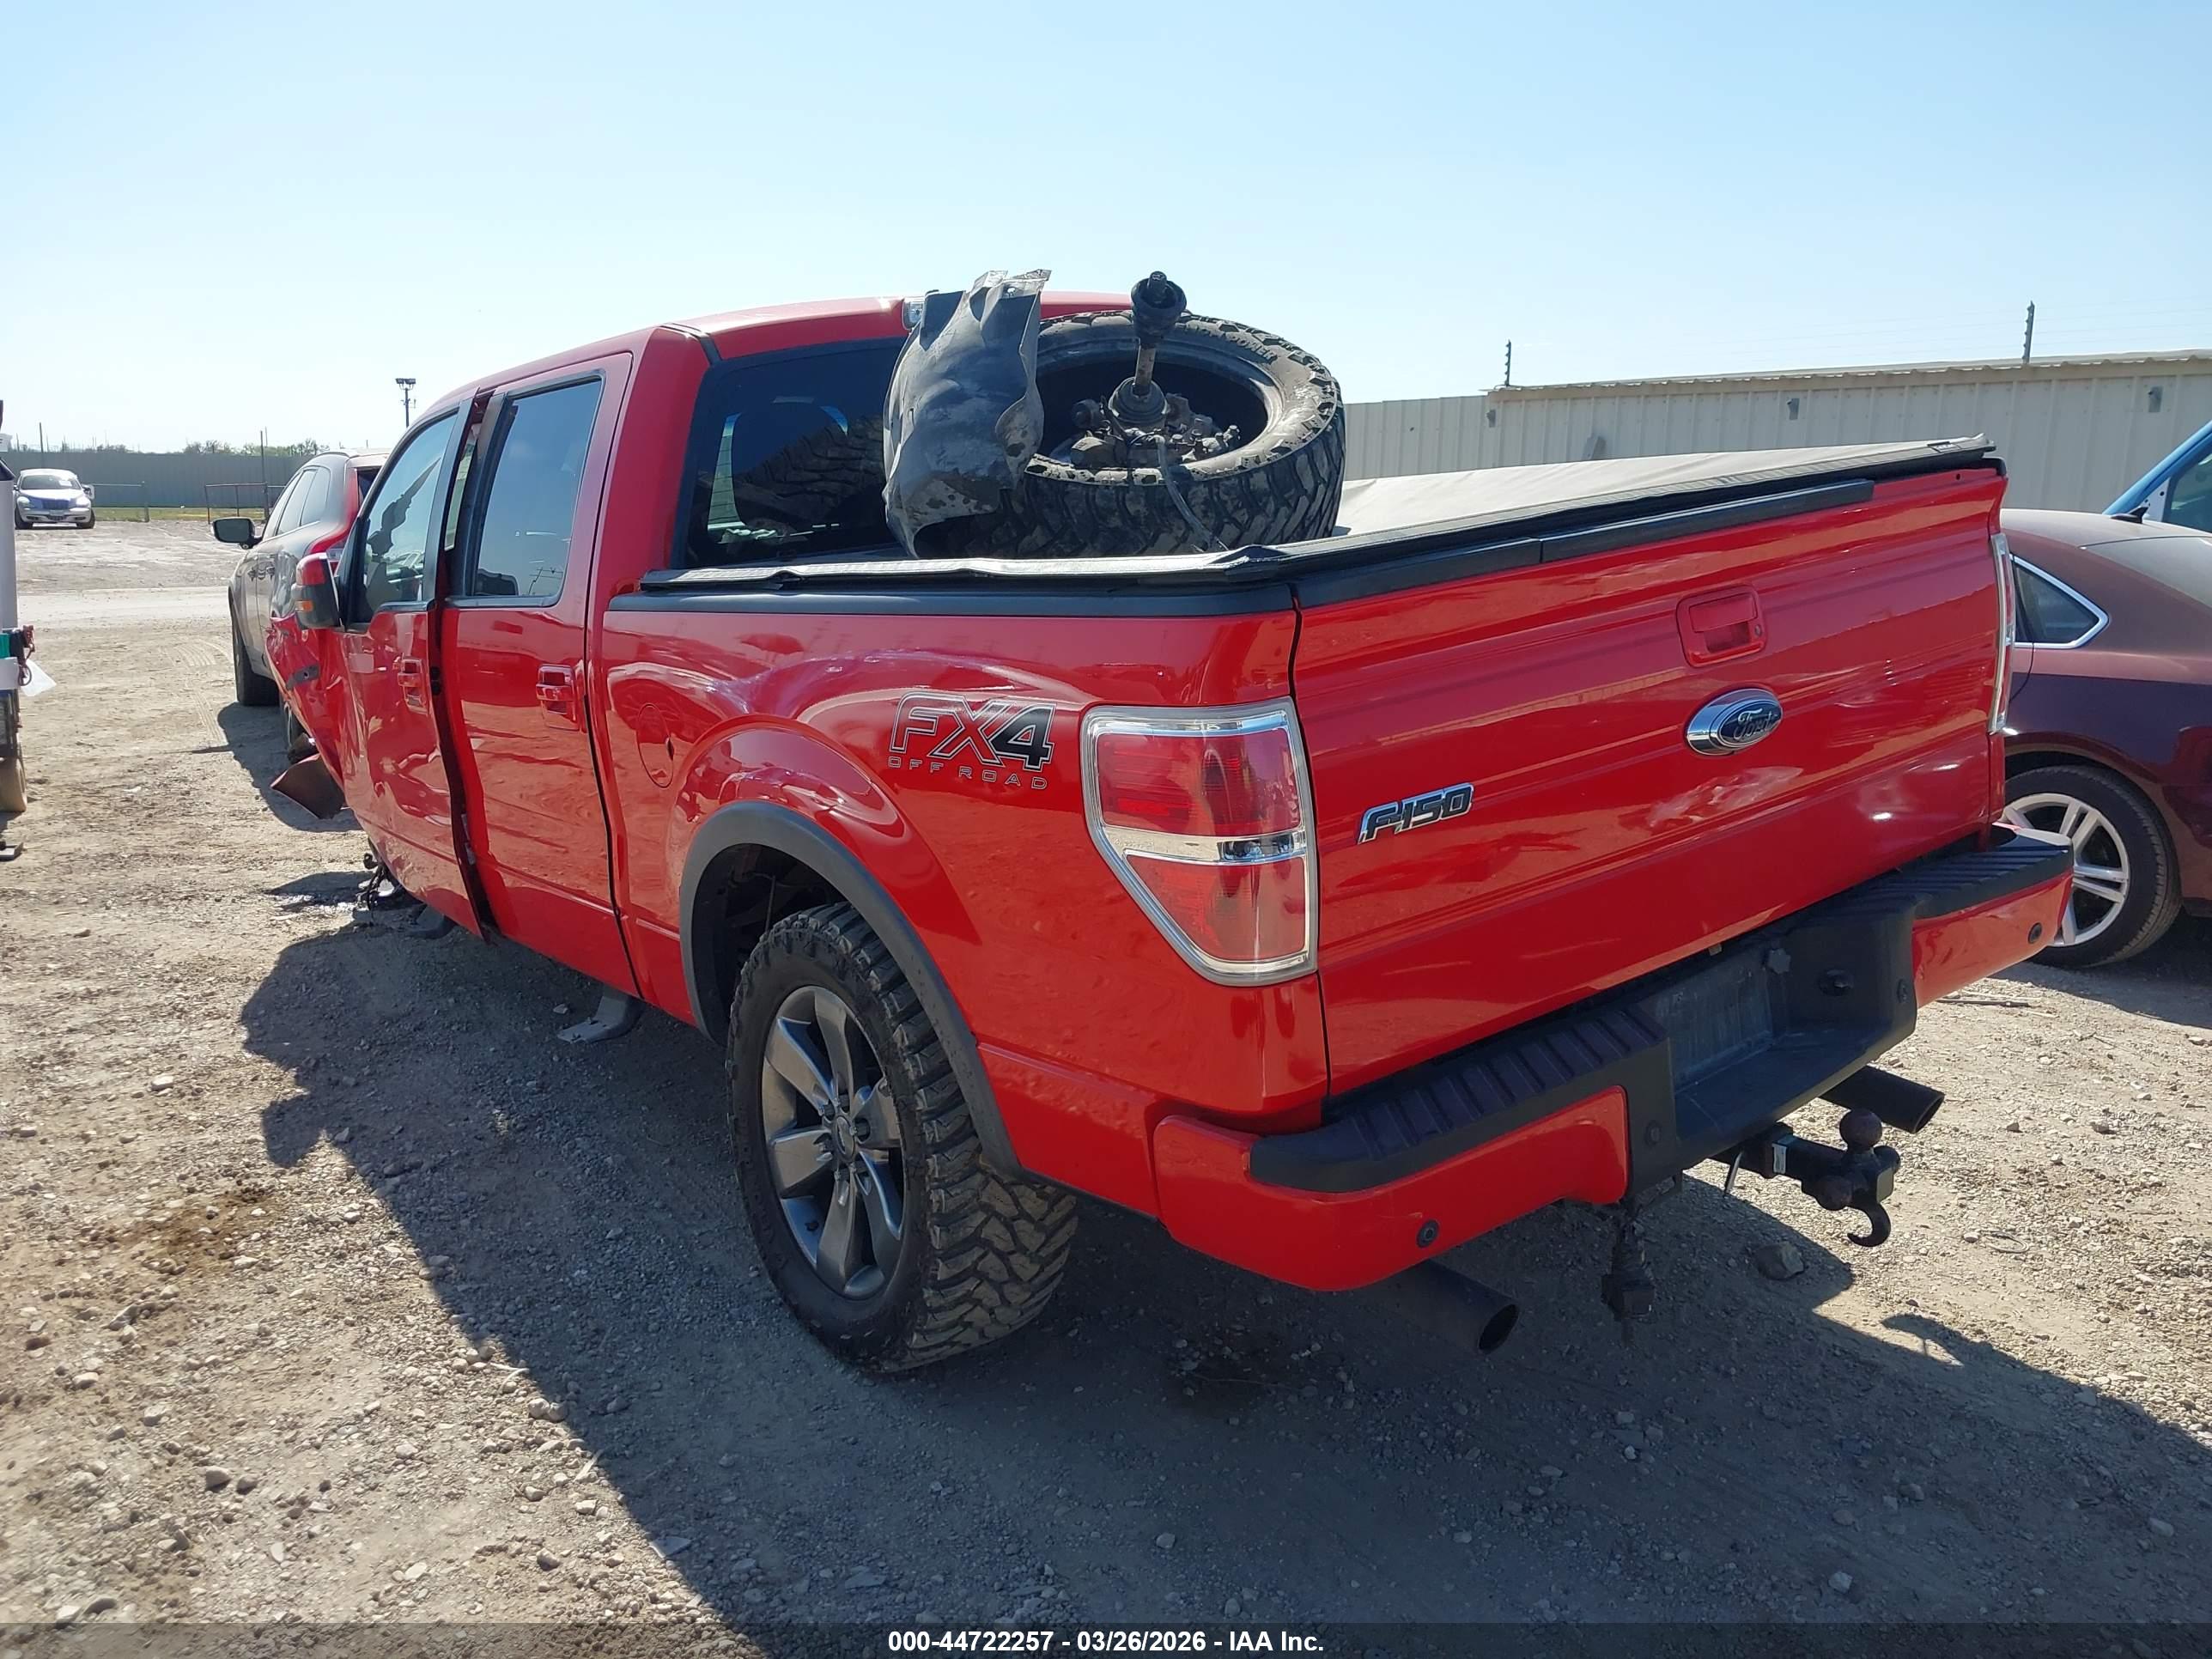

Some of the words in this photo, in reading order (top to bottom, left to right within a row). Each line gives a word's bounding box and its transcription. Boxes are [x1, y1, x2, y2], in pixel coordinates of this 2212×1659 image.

[1225, 331, 1277, 362] POWER
[889, 691, 1057, 772] FX4
[1733, 708, 1778, 739] Ford
[888, 757, 944, 773] OFF
[958, 766, 1048, 790] ROAD
